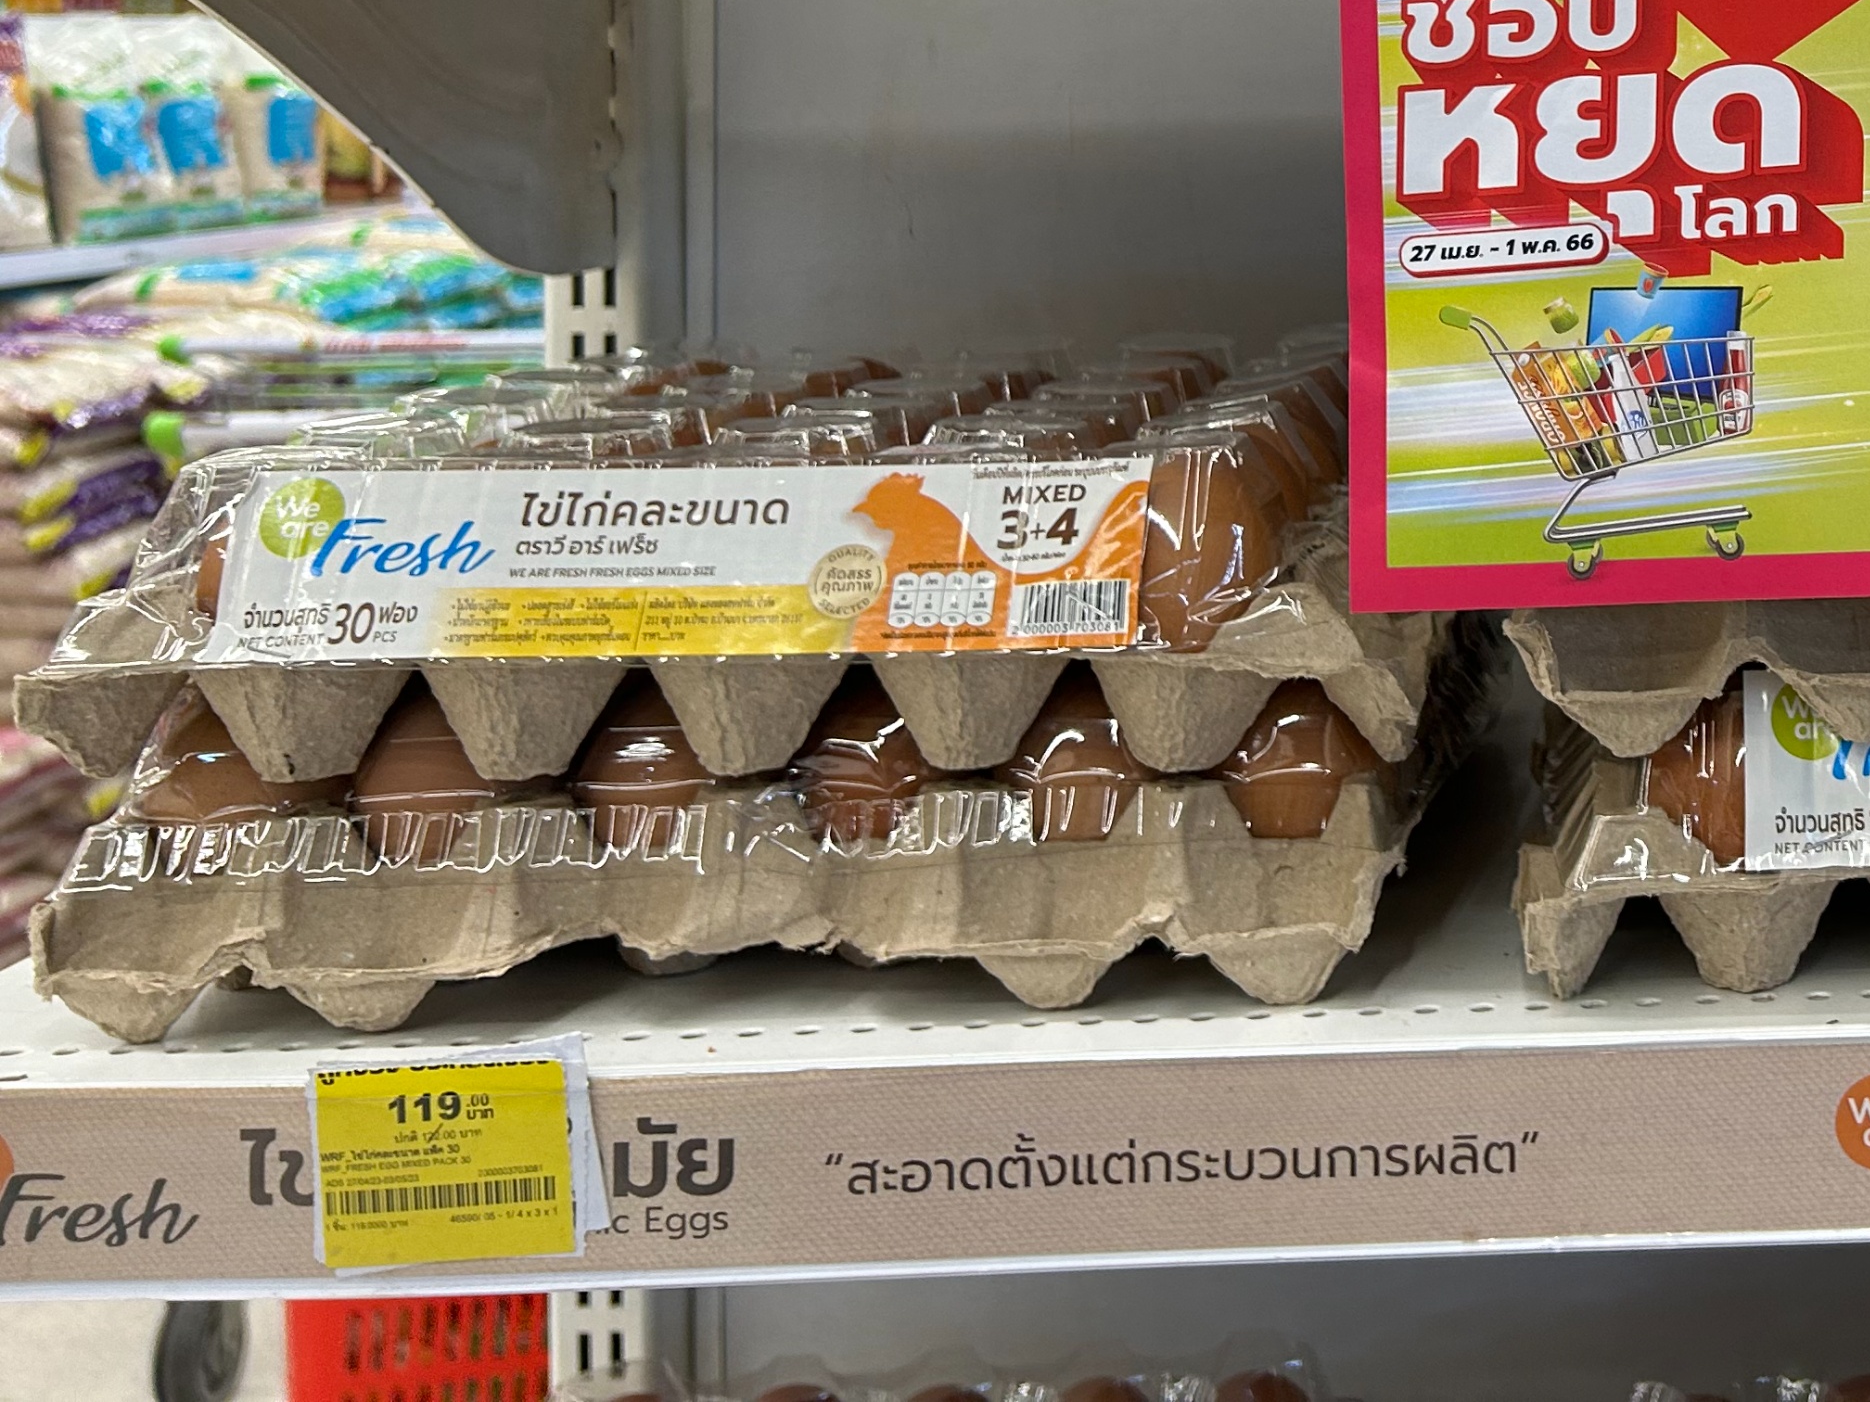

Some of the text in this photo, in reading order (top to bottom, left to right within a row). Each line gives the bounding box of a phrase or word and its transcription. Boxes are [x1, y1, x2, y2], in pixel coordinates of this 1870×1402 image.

[1404, 63, 1802, 238] หยุด
[1680, 184, 1796, 238] โลก
[1411, 244, 1436, 262] 27
[1506, 240, 1515, 256] 1
[1521, 238, 1560, 256] พ.ค.
[1566, 234, 1594, 252] 66
[520, 491, 789, 528] ไข่ไก่คละขนาด
[1003, 485, 1086, 505] MIXED
[997, 508, 1079, 549] 3+4
[310, 519, 495, 578] Fresh
[329, 603, 374, 646] 30
[379, 604, 418, 625] ฟอง
[388, 1092, 461, 1124] 119
[466, 1108, 494, 1120] บาท
[645, 1209, 728, 1238] Eggs
